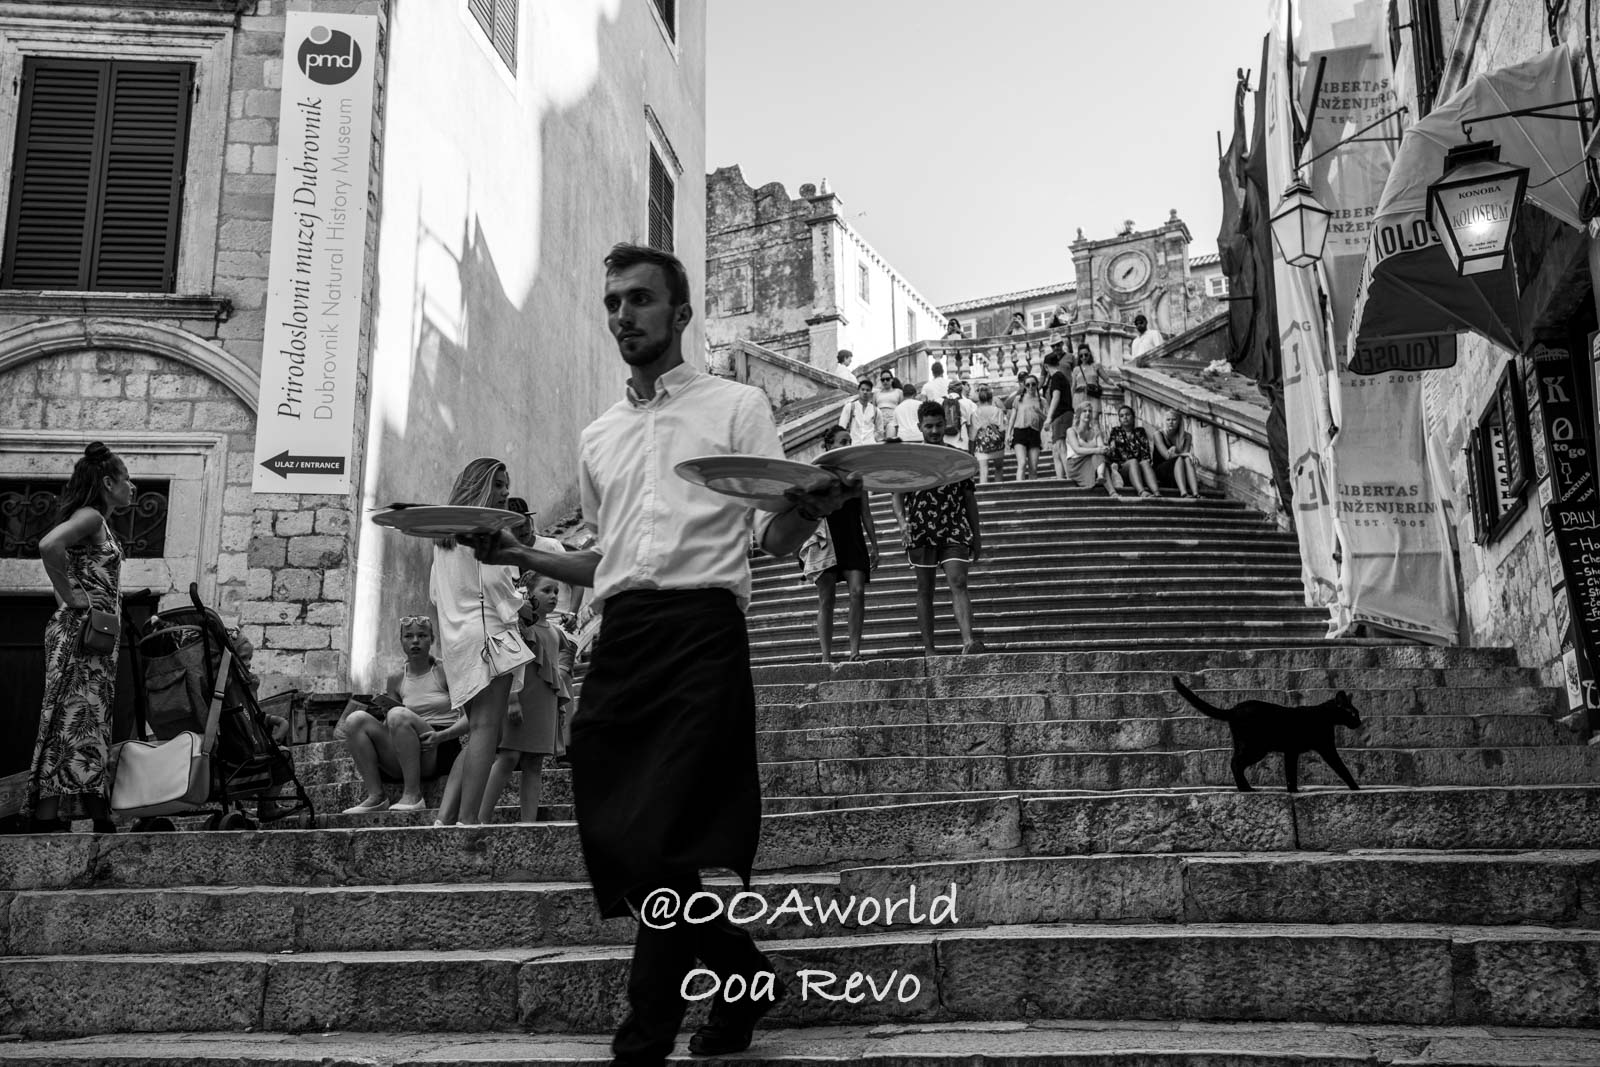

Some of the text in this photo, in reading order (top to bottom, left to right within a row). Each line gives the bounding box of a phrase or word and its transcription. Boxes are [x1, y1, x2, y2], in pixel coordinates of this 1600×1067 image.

[306, 37, 355, 78] pmd
[1320, 79, 1389, 93] IBERTAS
[1458, 185, 1502, 199] KONOBA
[1453, 203, 1508, 228] KOLOSEUM
[277, 97, 323, 420] Prirodoslovni muzej Dubrovnik
[313, 98, 352, 420] Dubrovnik Natural History Museum
[300, 461, 340, 469] ENTRANCE
[1561, 471, 1591, 502] COCKTAILS
[1560, 510, 1595, 528] DAILY
